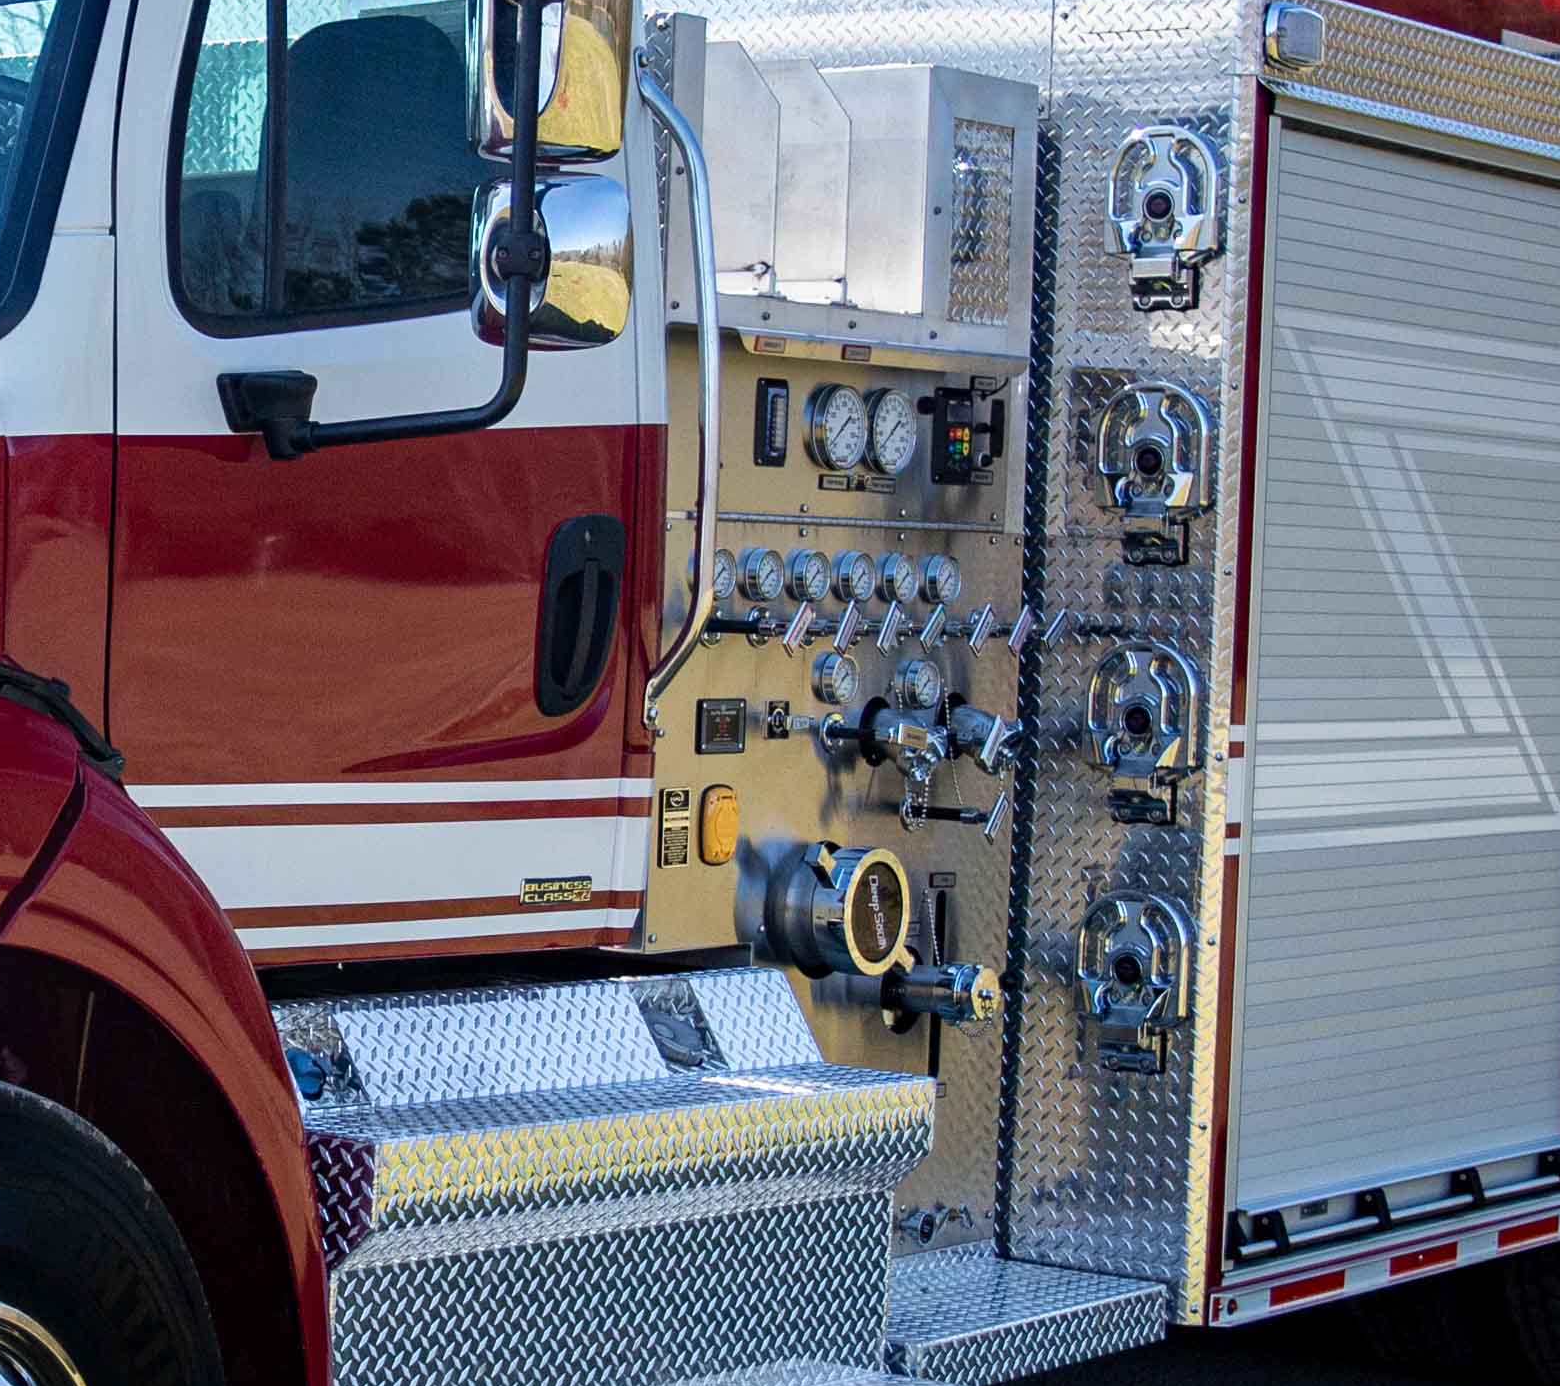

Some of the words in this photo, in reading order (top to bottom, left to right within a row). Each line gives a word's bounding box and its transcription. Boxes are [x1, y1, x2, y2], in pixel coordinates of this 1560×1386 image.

[525, 881, 591, 892] BUSINESS
[525, 892, 572, 902] CLASS
[868, 875, 880, 911] Deep
